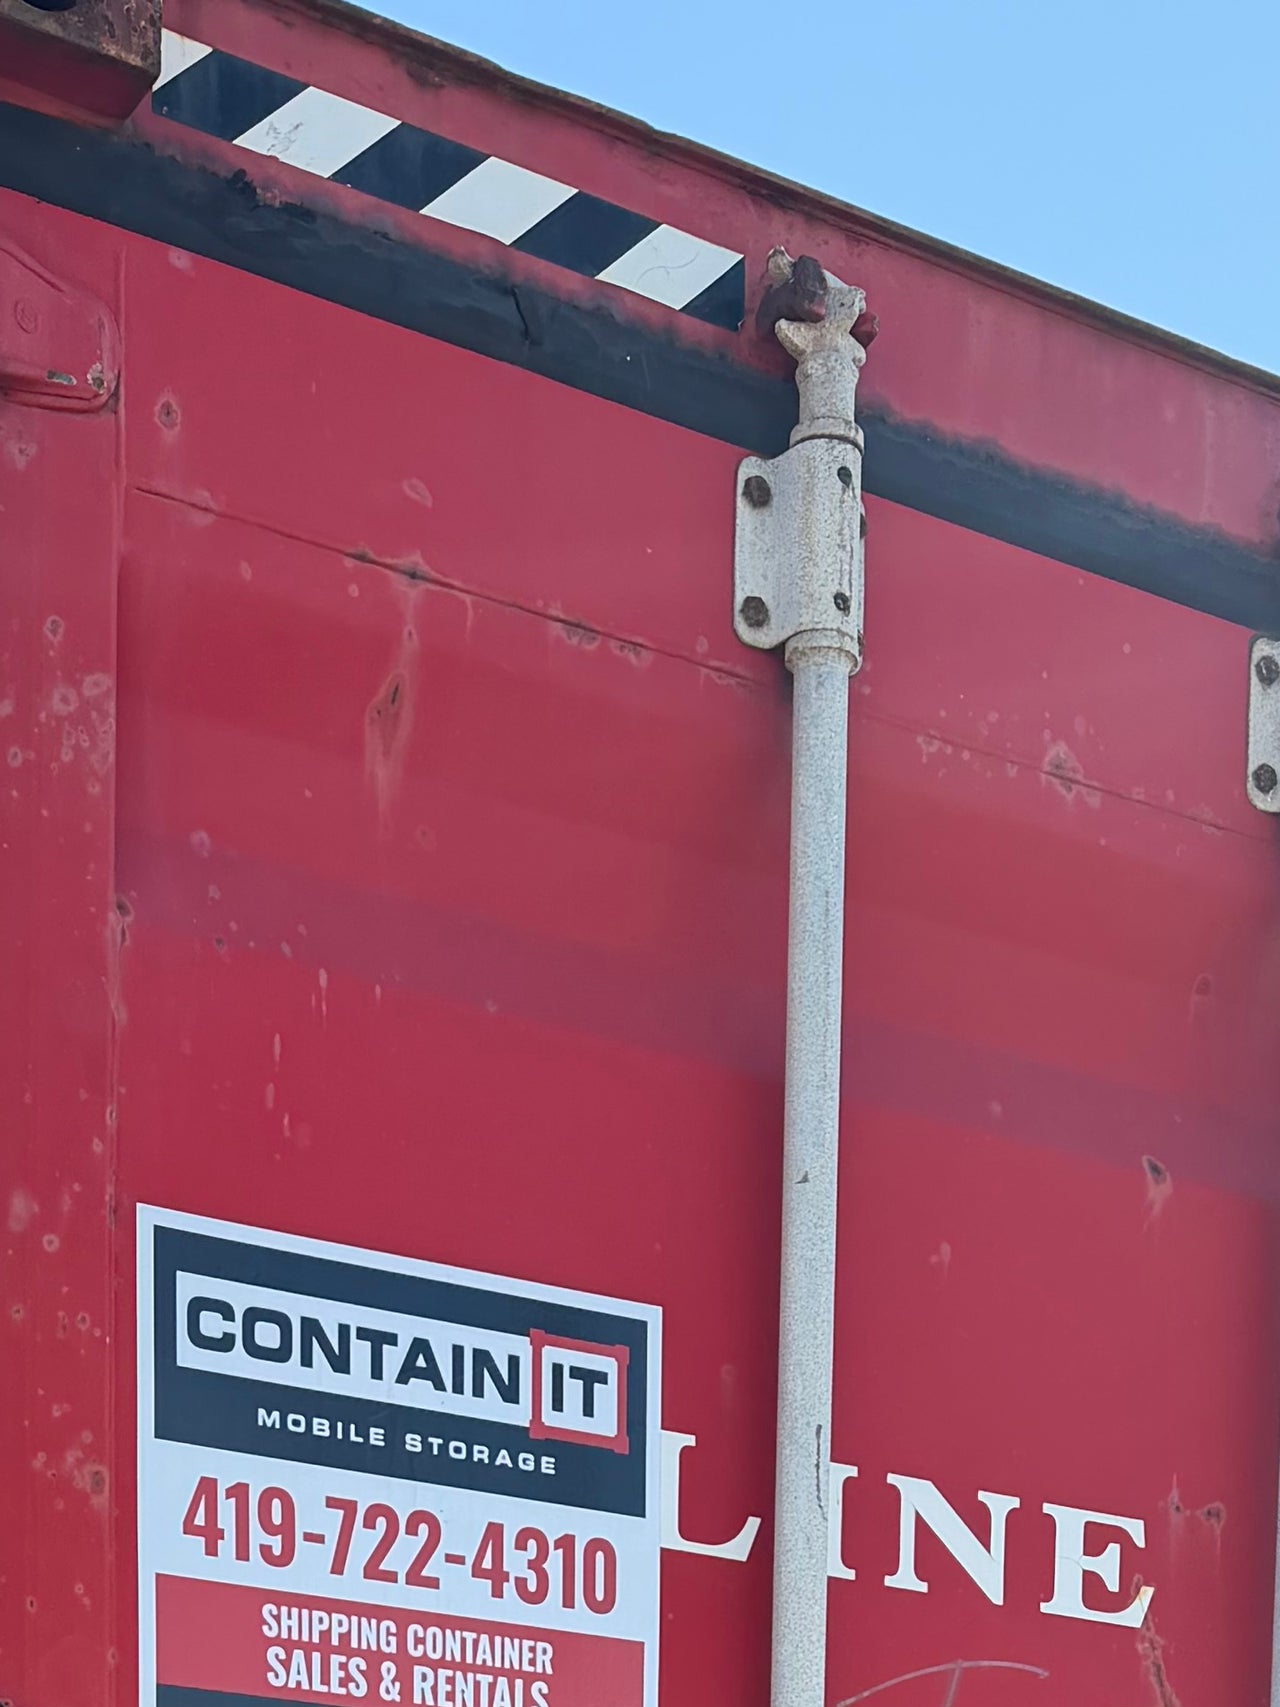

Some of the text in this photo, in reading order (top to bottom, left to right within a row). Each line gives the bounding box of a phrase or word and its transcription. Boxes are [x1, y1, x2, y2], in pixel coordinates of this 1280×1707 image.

[257, 1407, 557, 1475] MOBILE STORAGE
[181, 1475, 617, 1615] 419-722-4310
[261, 1602, 554, 1675] SHIPPING CONTAINER
[266, 1645, 368, 1699] SALES
[379, 1665, 402, 1704] &
